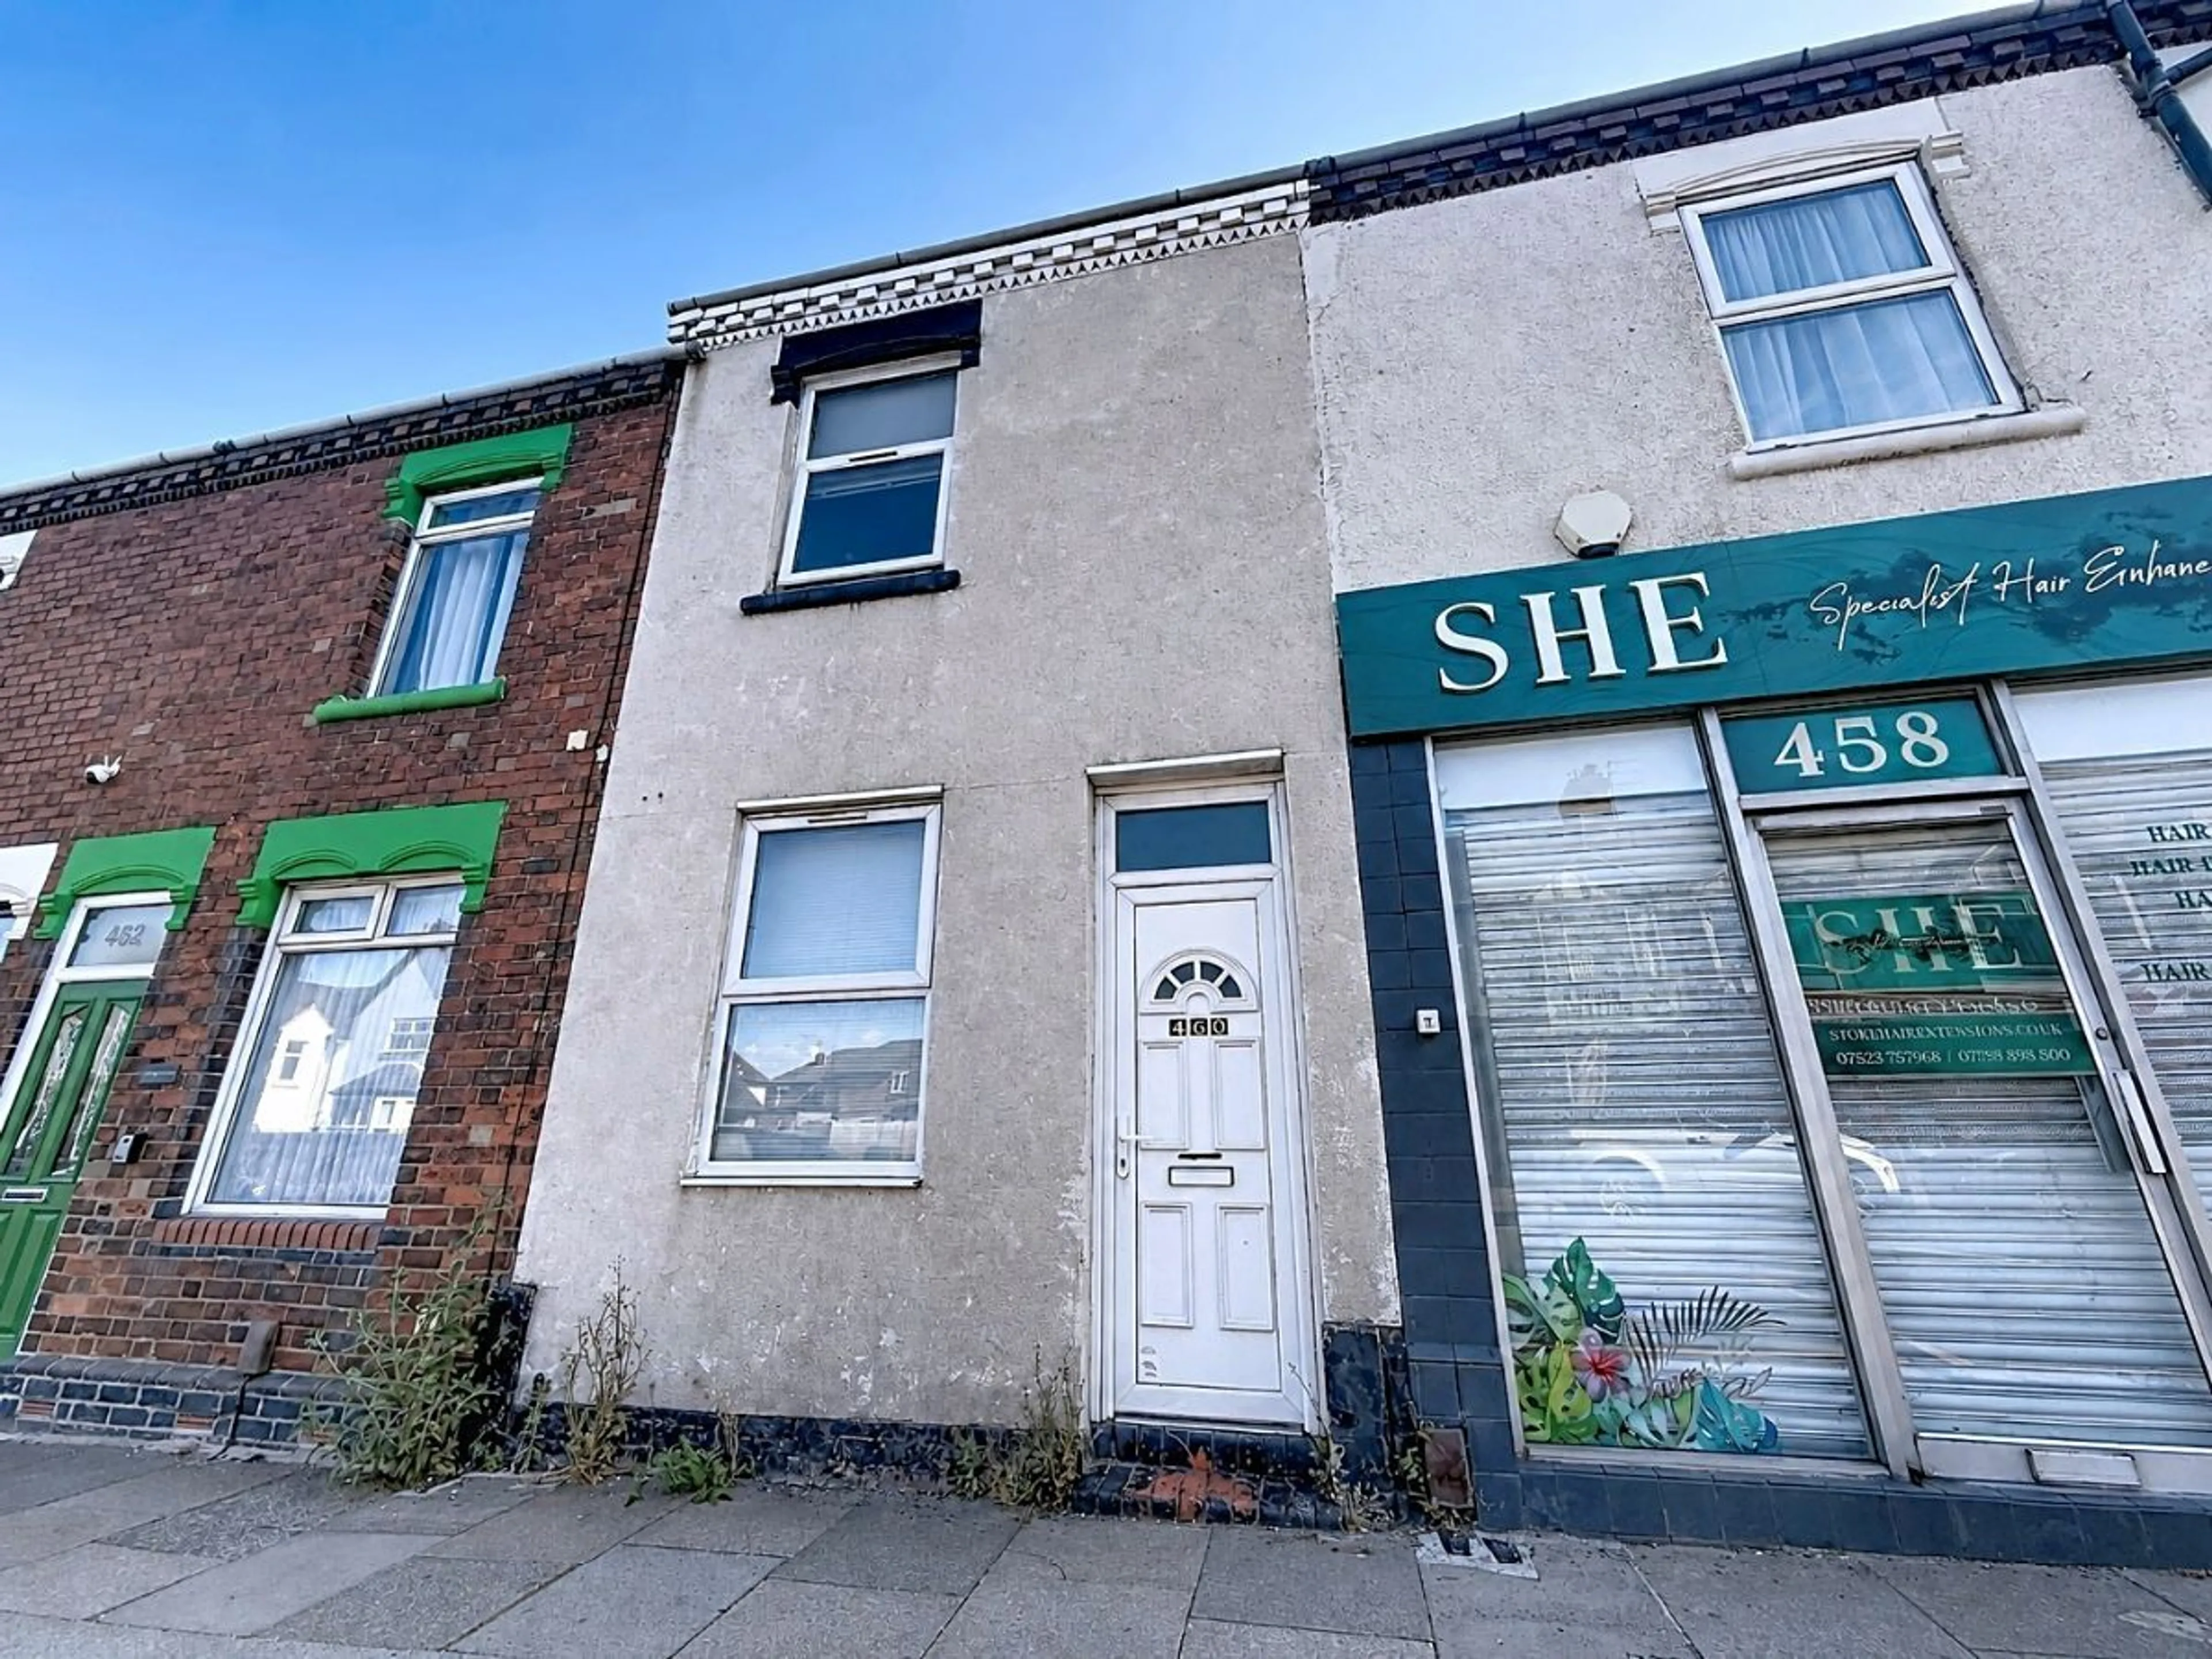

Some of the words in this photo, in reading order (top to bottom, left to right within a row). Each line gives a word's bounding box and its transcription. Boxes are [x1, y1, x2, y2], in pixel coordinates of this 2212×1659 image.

[1810, 563, 1979, 650] Specialist
[1993, 558, 2071, 603] Hair
[1434, 572, 1727, 692] SHE
[1774, 711, 1949, 777] 458
[2147, 823, 2211, 843] HAIR
[2130, 857, 2194, 876] HAIR
[105, 925, 145, 946] 462
[1815, 904, 2023, 974] SHE
[2141, 961, 2211, 982] HAIR
[1172, 1018, 1225, 1036] 460
